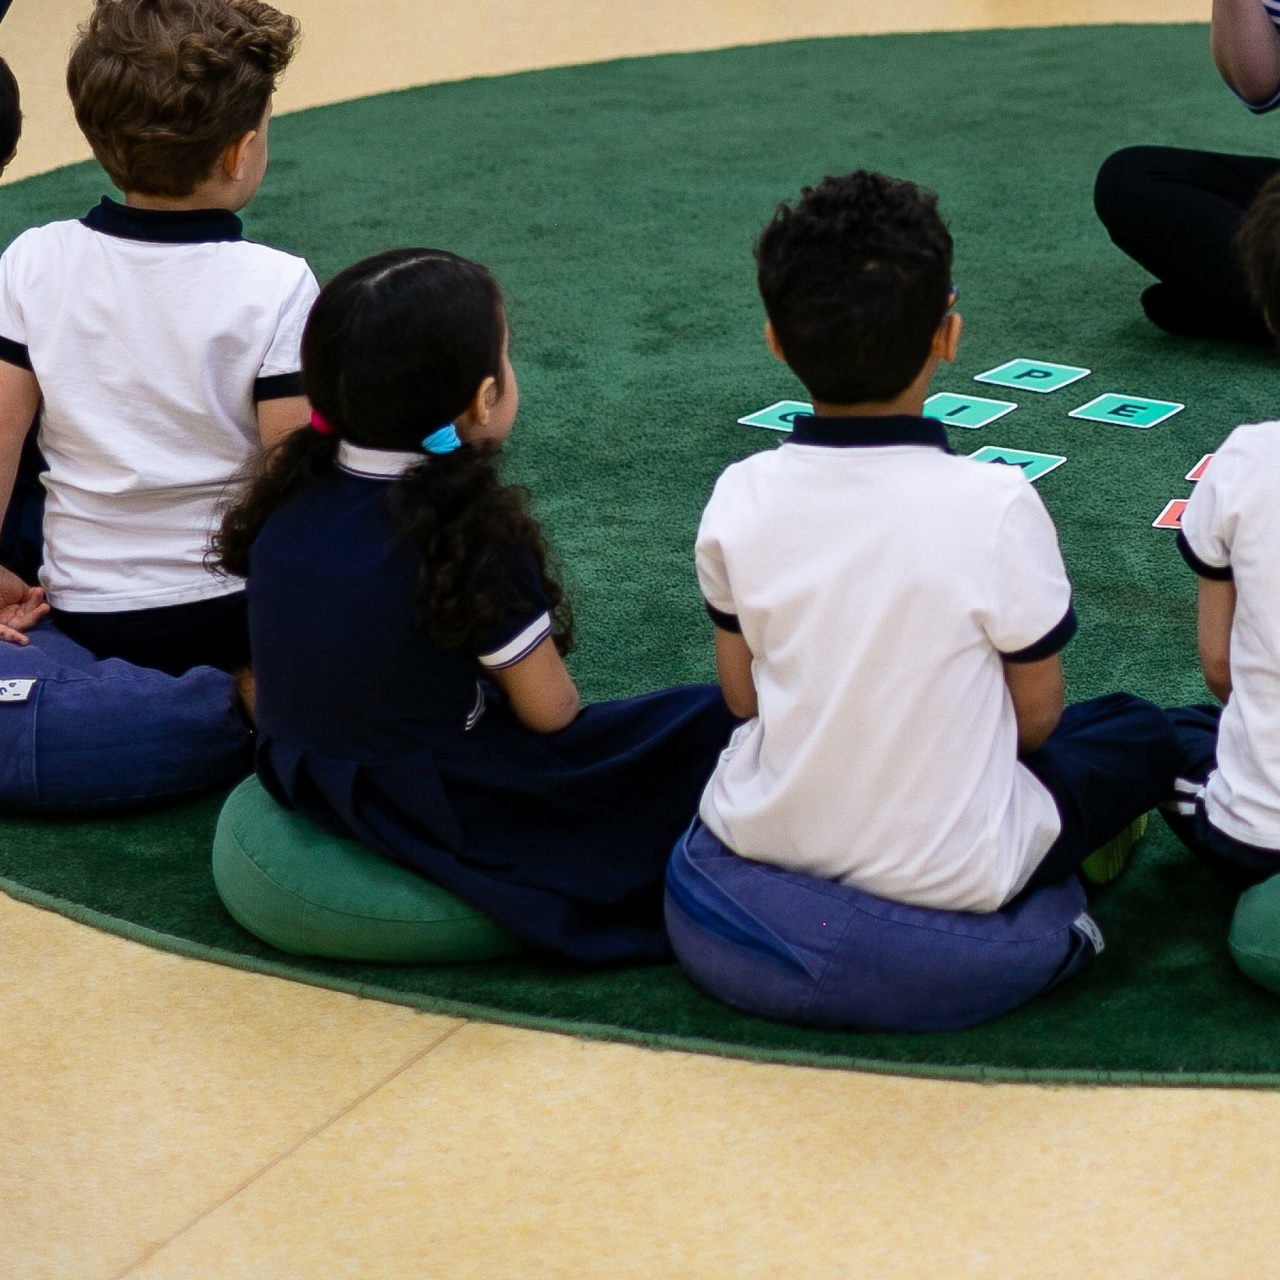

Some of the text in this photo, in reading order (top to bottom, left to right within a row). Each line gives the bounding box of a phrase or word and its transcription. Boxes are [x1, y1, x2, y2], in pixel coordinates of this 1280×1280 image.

[1013, 368, 1053, 381] P
[945, 405, 971, 417] I
[1106, 403, 1149, 419] E
